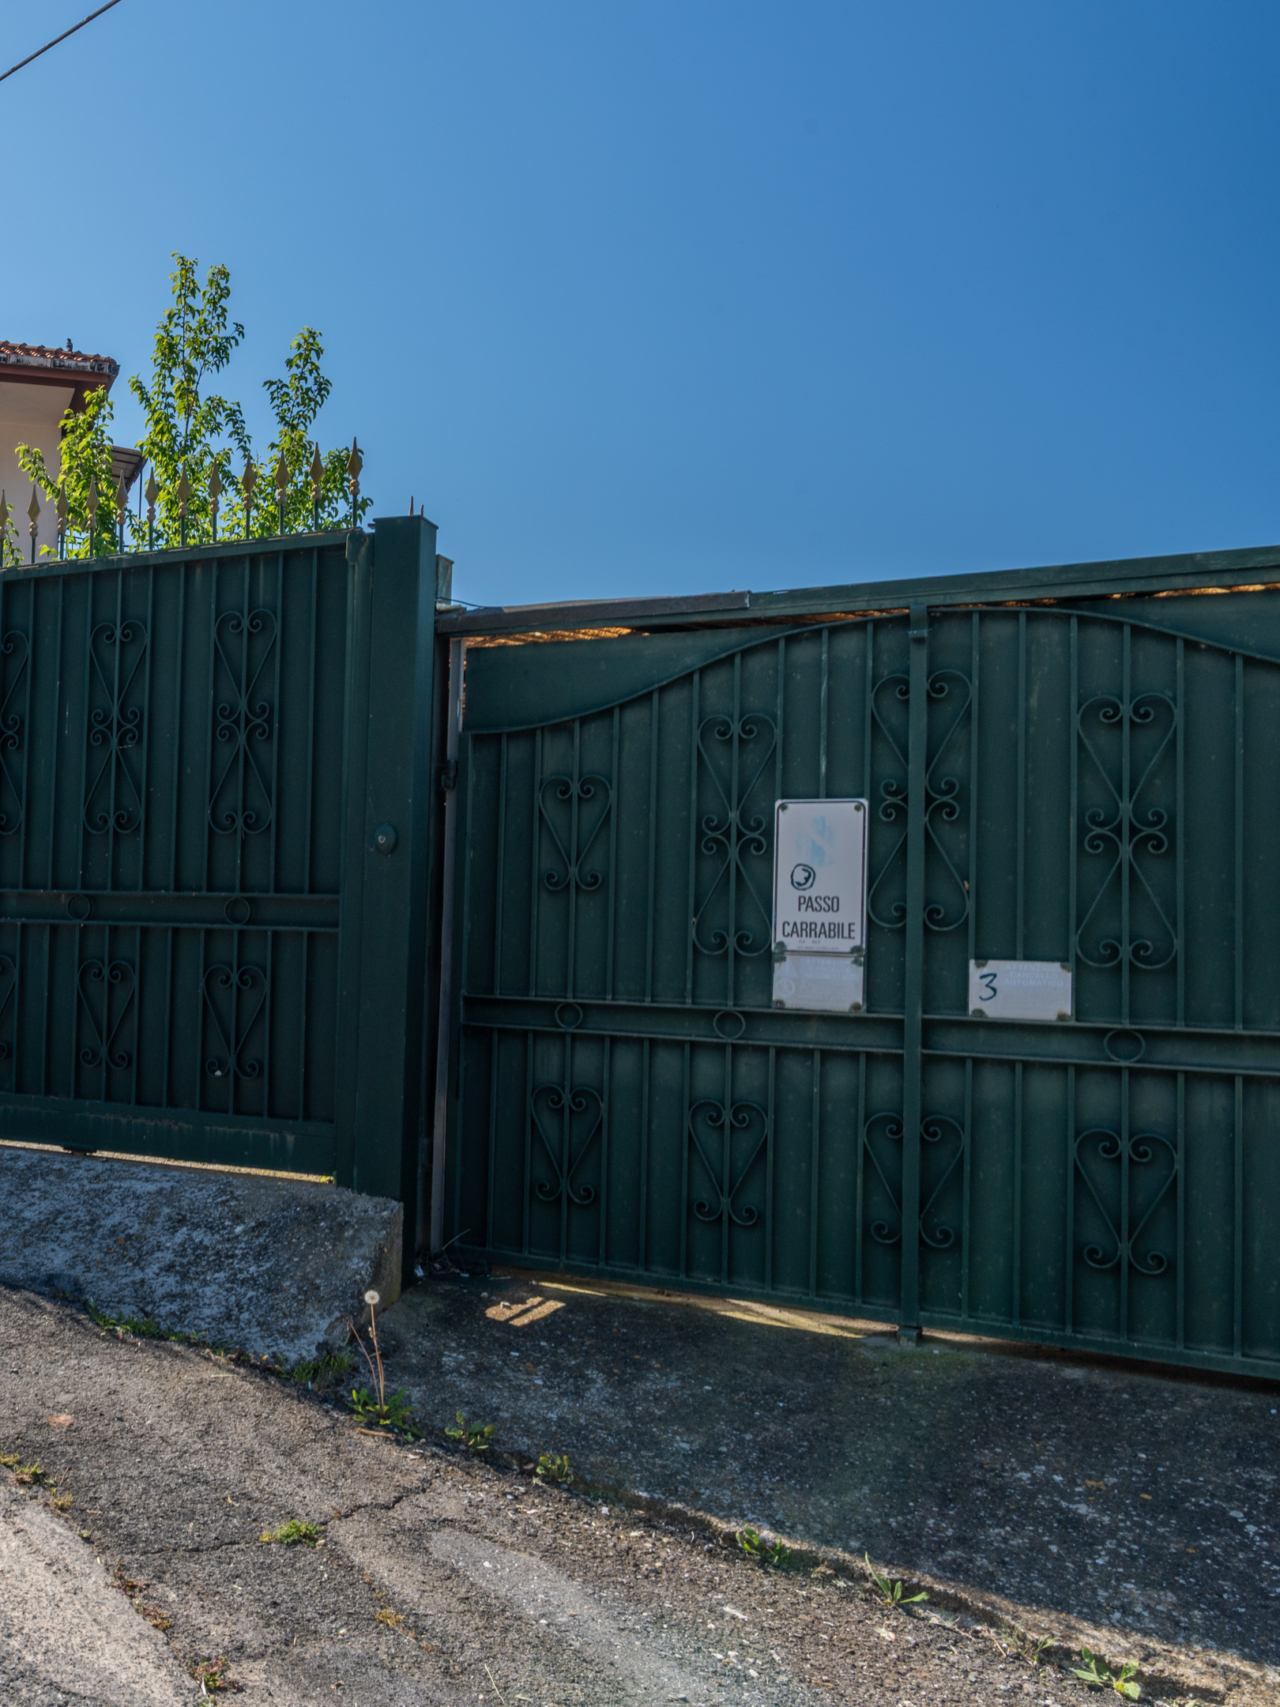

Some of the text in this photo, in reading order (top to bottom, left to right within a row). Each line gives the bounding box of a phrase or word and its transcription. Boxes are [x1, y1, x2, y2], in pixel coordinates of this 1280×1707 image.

[798, 895, 840, 913] PASSO
[782, 921, 856, 940] CARRABILE
[979, 973, 997, 1001] 3
